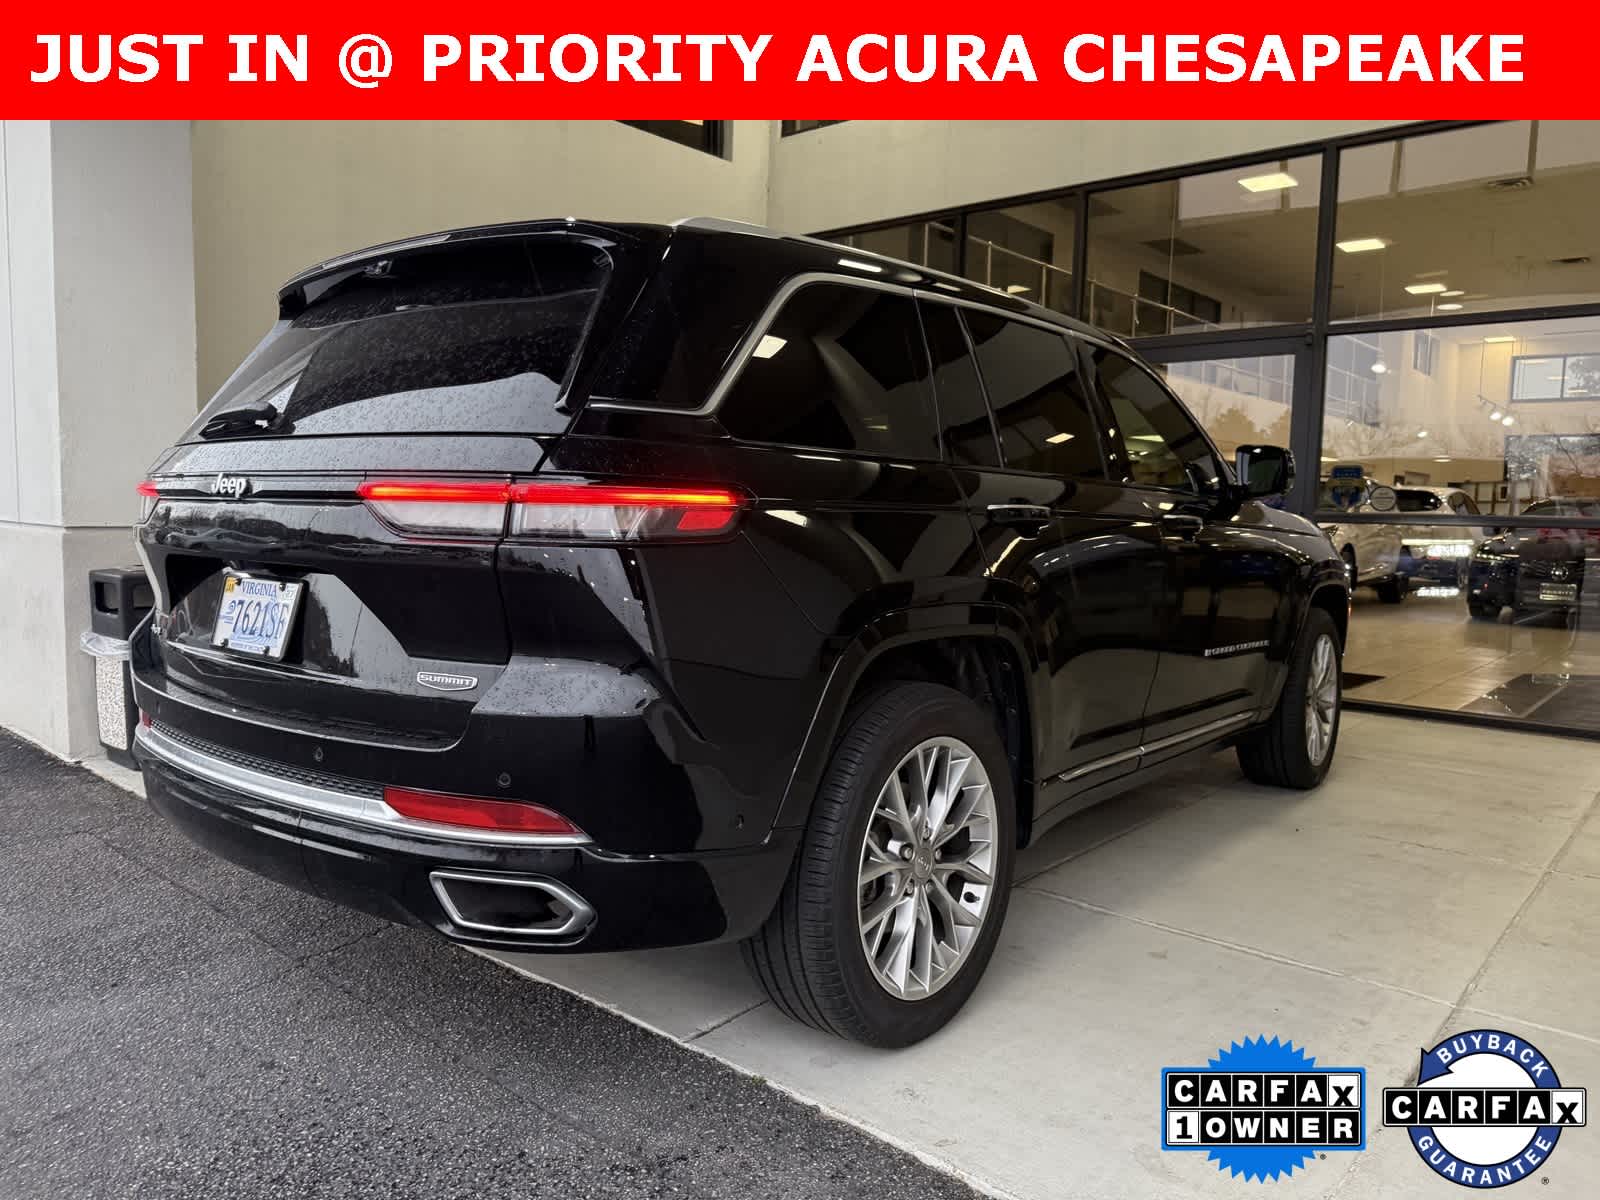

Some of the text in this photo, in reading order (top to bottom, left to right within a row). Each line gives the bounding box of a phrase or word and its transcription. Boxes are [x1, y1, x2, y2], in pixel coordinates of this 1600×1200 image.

[211, 472, 246, 498] Jeep
[241, 581, 277, 598] VIRGINIA
[420, 674, 473, 686] SUMMIT
